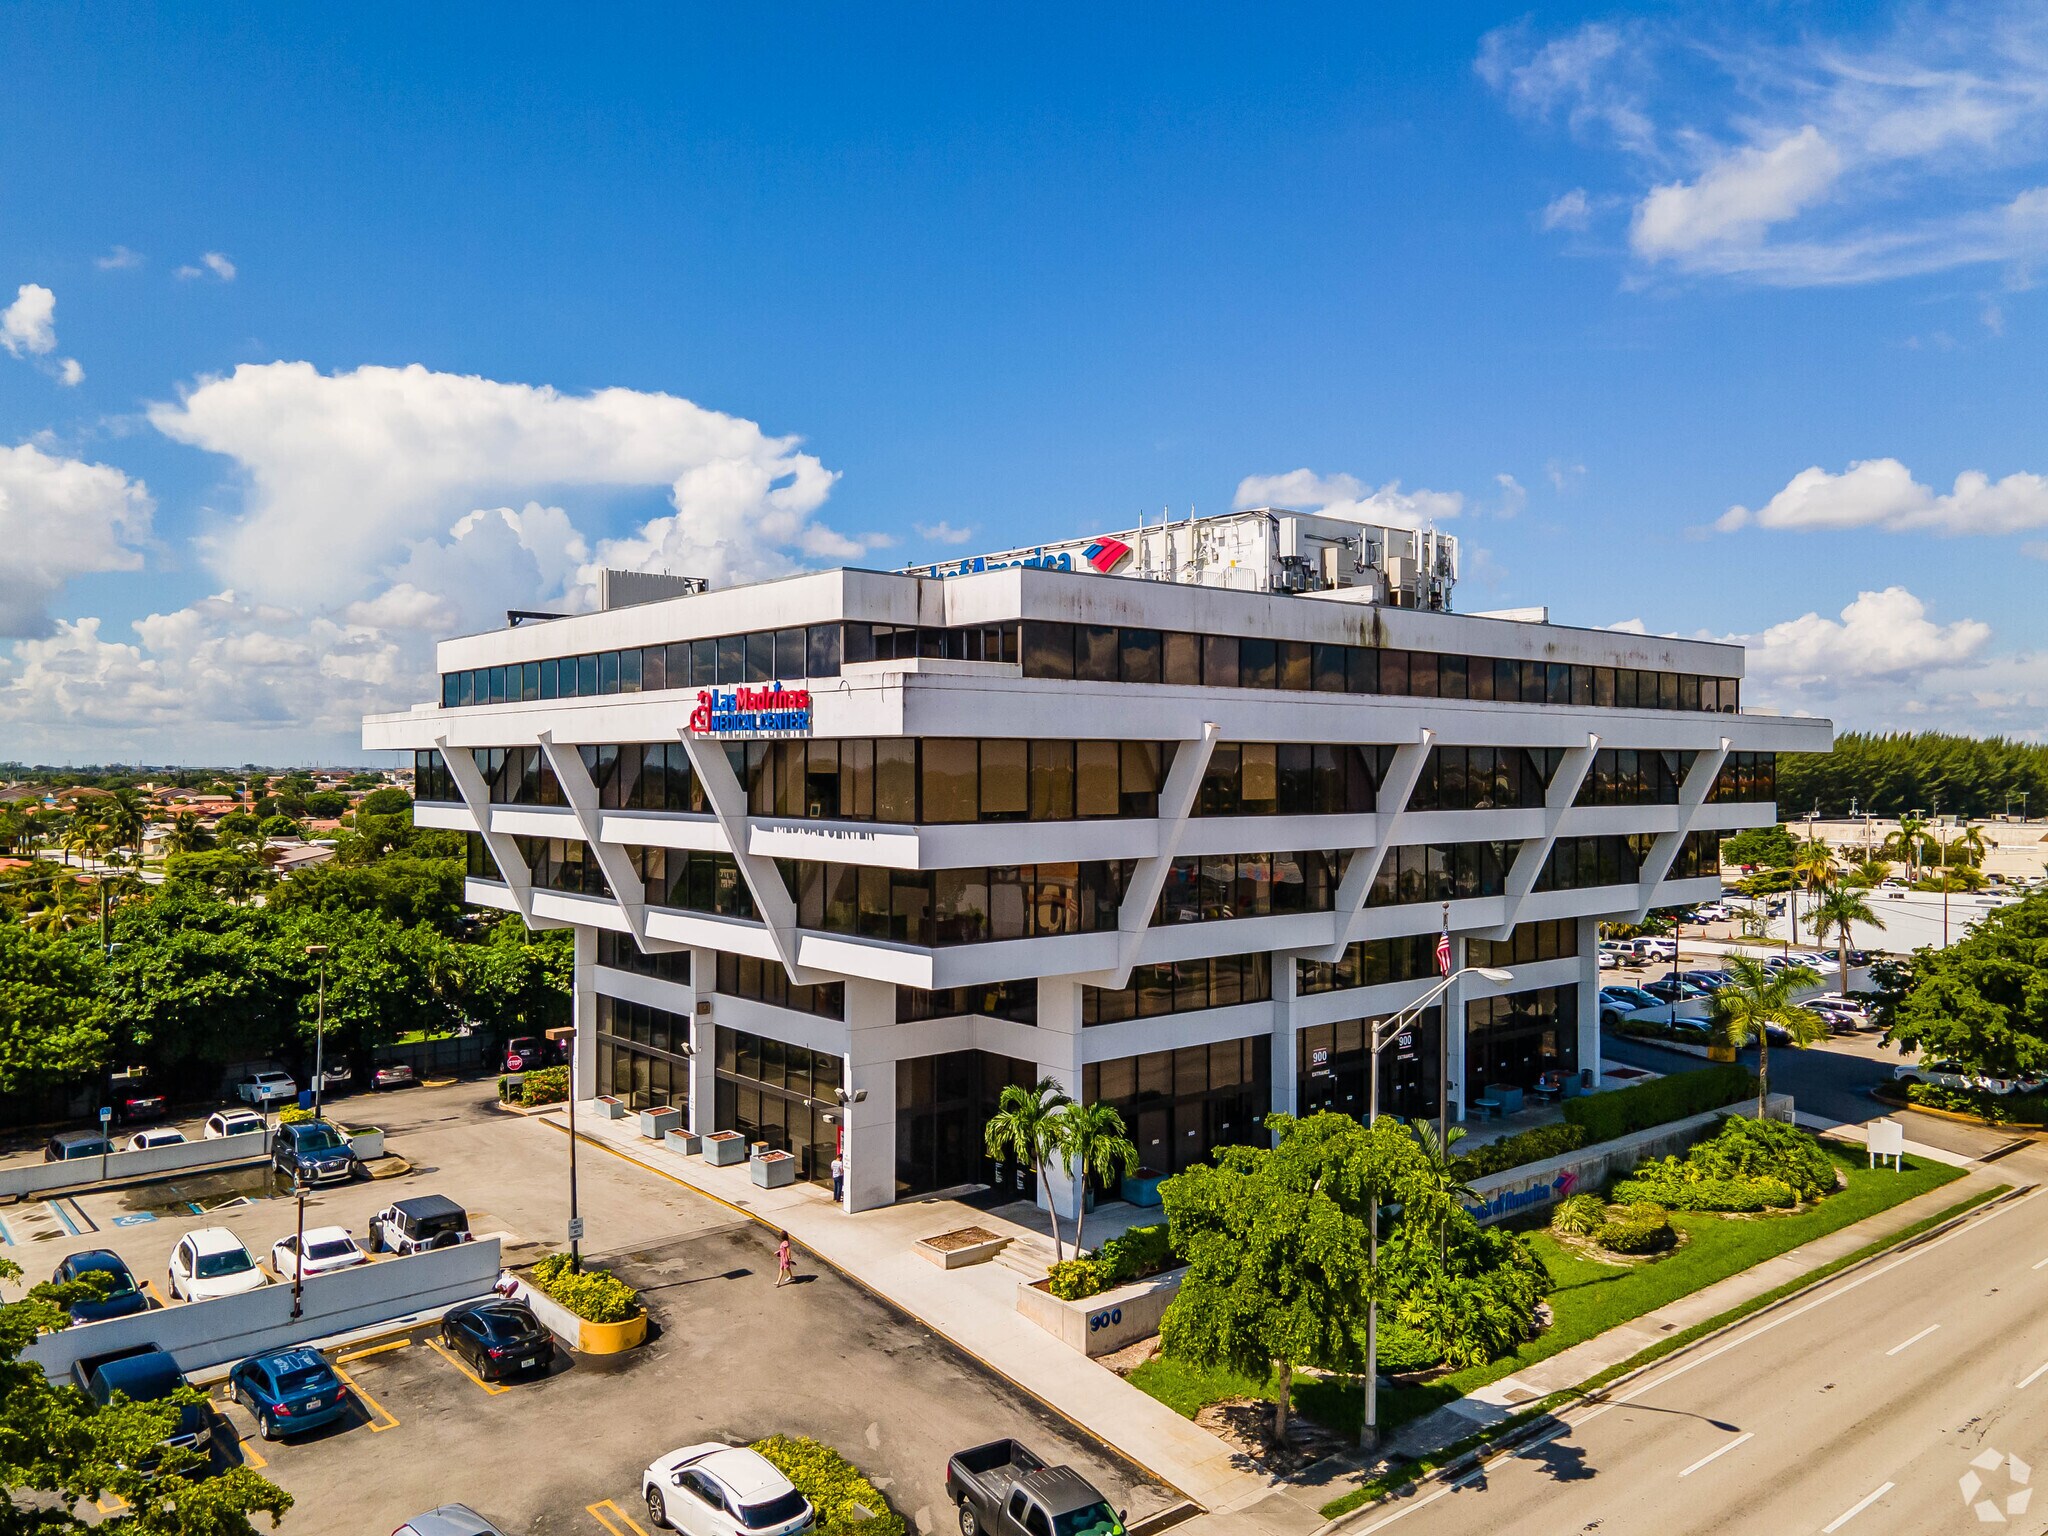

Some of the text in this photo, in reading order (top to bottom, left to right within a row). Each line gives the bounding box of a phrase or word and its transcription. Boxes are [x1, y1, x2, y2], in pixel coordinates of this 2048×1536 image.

[711, 711, 809, 731] MEDICAL CENTER
[1398, 1035, 1412, 1046] 900
[1312, 1050, 1327, 1063] 900
[1505, 1183, 1551, 1210] America
[1090, 1308, 1122, 1332] 900
